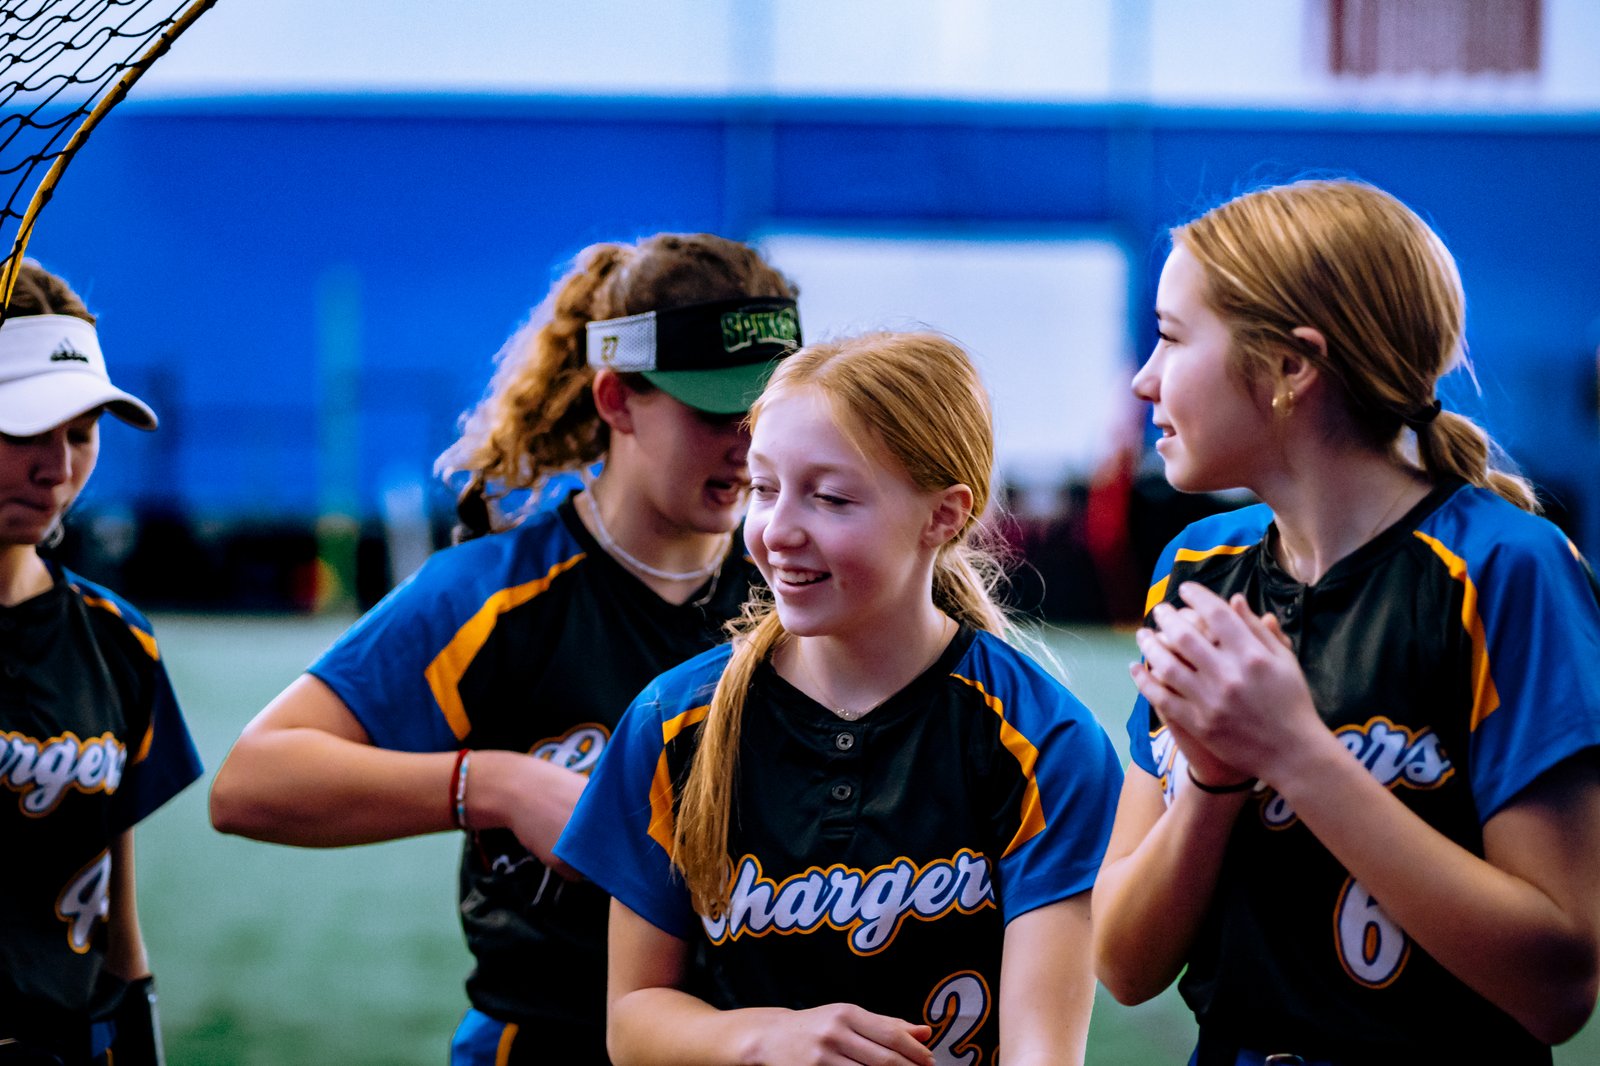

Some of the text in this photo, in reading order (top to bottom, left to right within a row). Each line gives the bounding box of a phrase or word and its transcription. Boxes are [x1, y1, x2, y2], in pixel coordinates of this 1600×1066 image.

[54, 848, 111, 954] 4
[701, 848, 996, 956] harger
[1333, 874, 1411, 989] 6
[923, 970, 1000, 1066] 2
